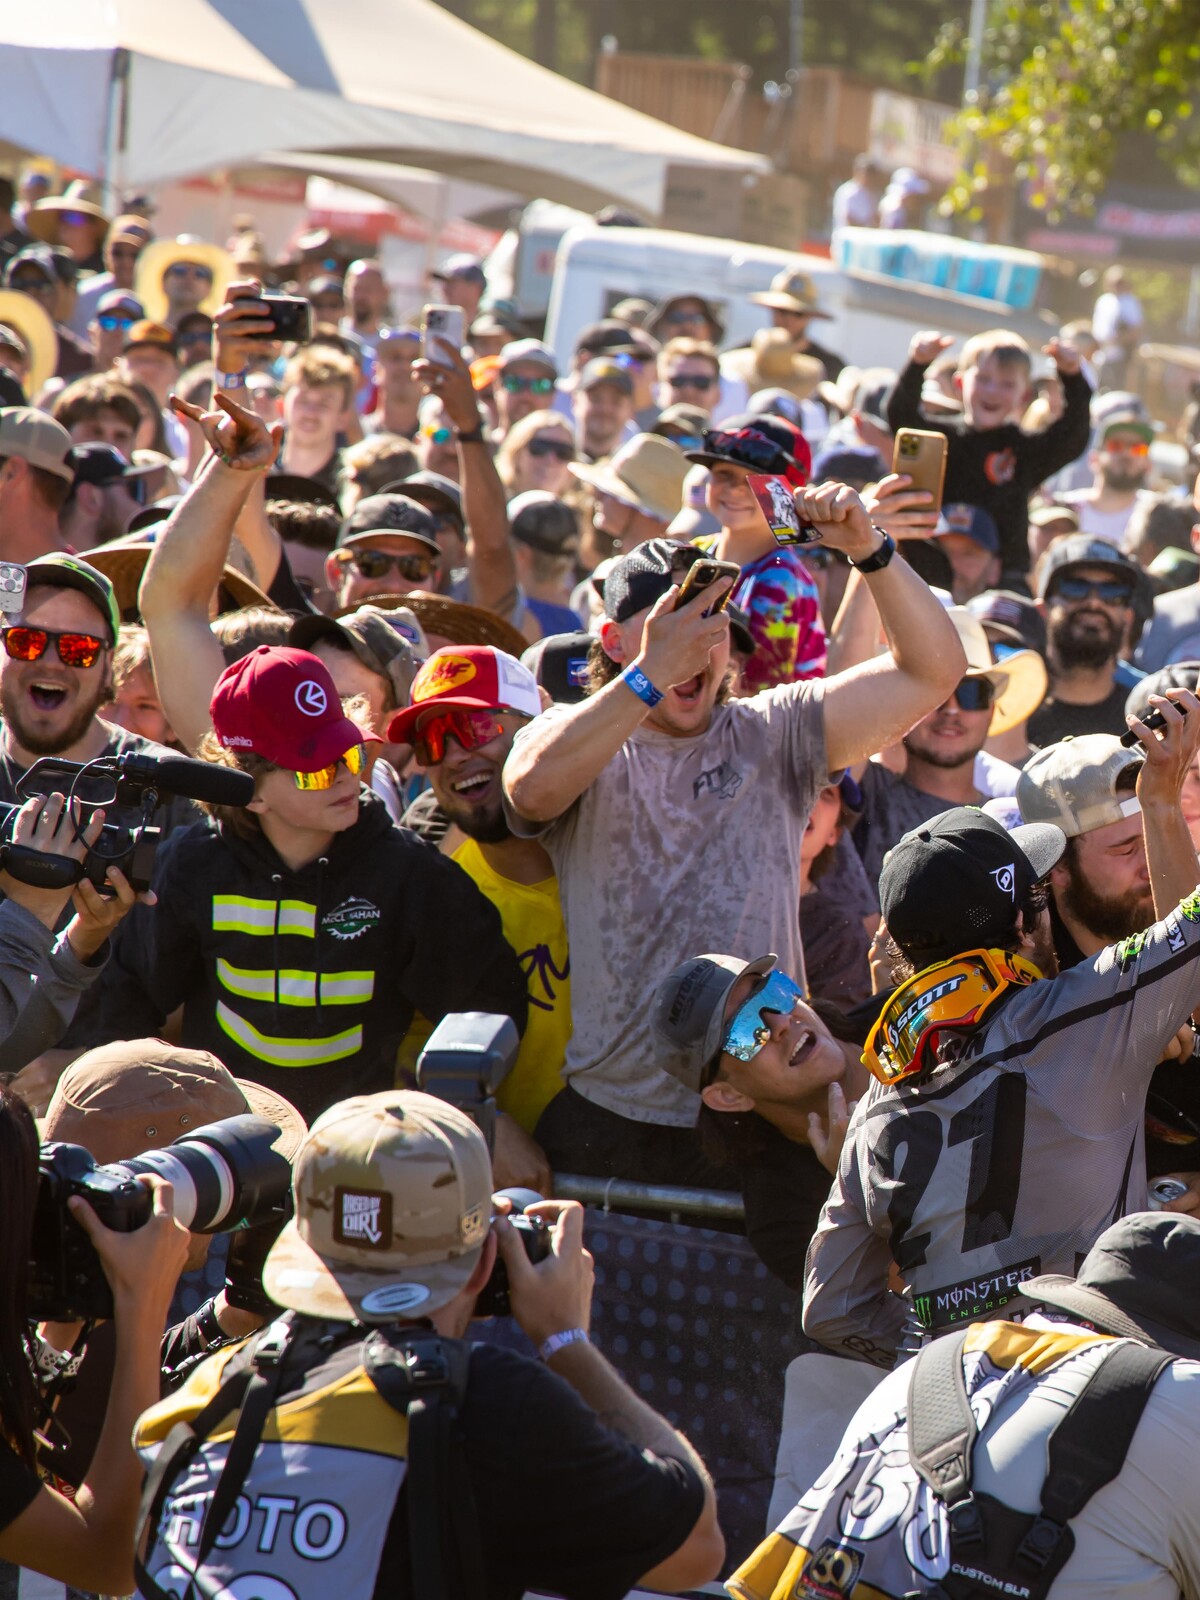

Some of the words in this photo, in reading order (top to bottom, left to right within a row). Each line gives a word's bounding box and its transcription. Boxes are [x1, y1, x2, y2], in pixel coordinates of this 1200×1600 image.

[897, 976, 964, 1033] SCOTT
[872, 1071, 1028, 1275] 21
[342, 1209, 382, 1244] DIRT
[949, 1294, 1017, 1321] ENERG
[951, 1563, 1004, 1590] CUSTOM
[1004, 1582, 1031, 1598] SLR
